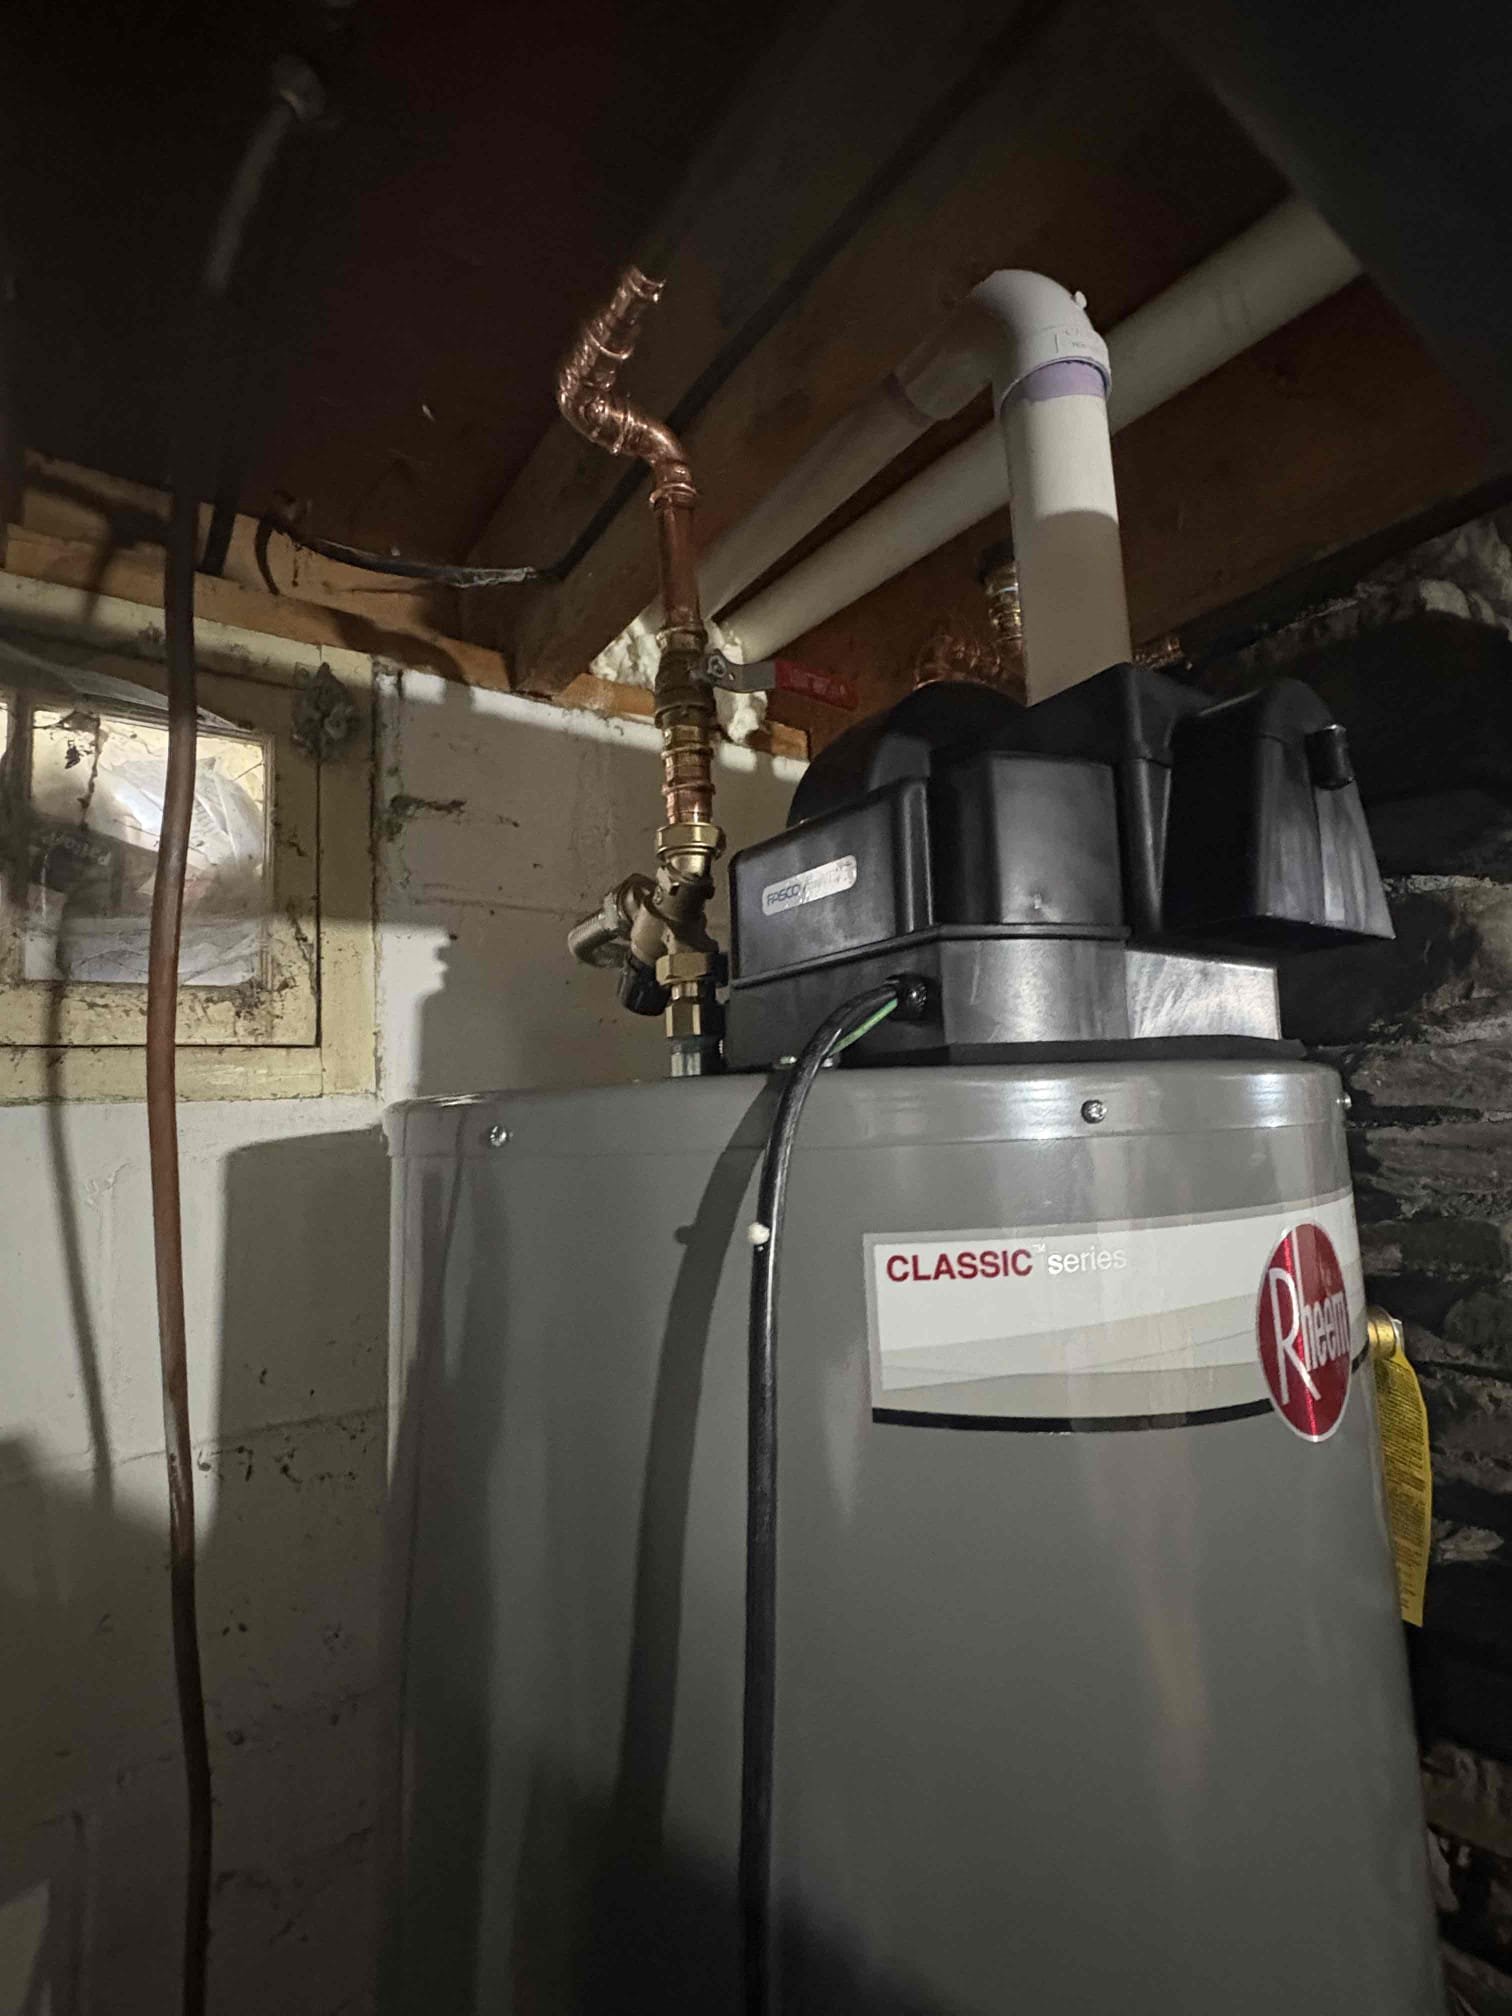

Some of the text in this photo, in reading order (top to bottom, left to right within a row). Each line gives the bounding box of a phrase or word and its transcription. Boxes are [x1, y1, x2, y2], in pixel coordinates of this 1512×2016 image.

[766, 883, 801, 907] FASCO
[887, 1249, 1033, 1282] CLASSIC
[1048, 1245, 1128, 1275] series
[1269, 1229, 1351, 1405] Rheem
